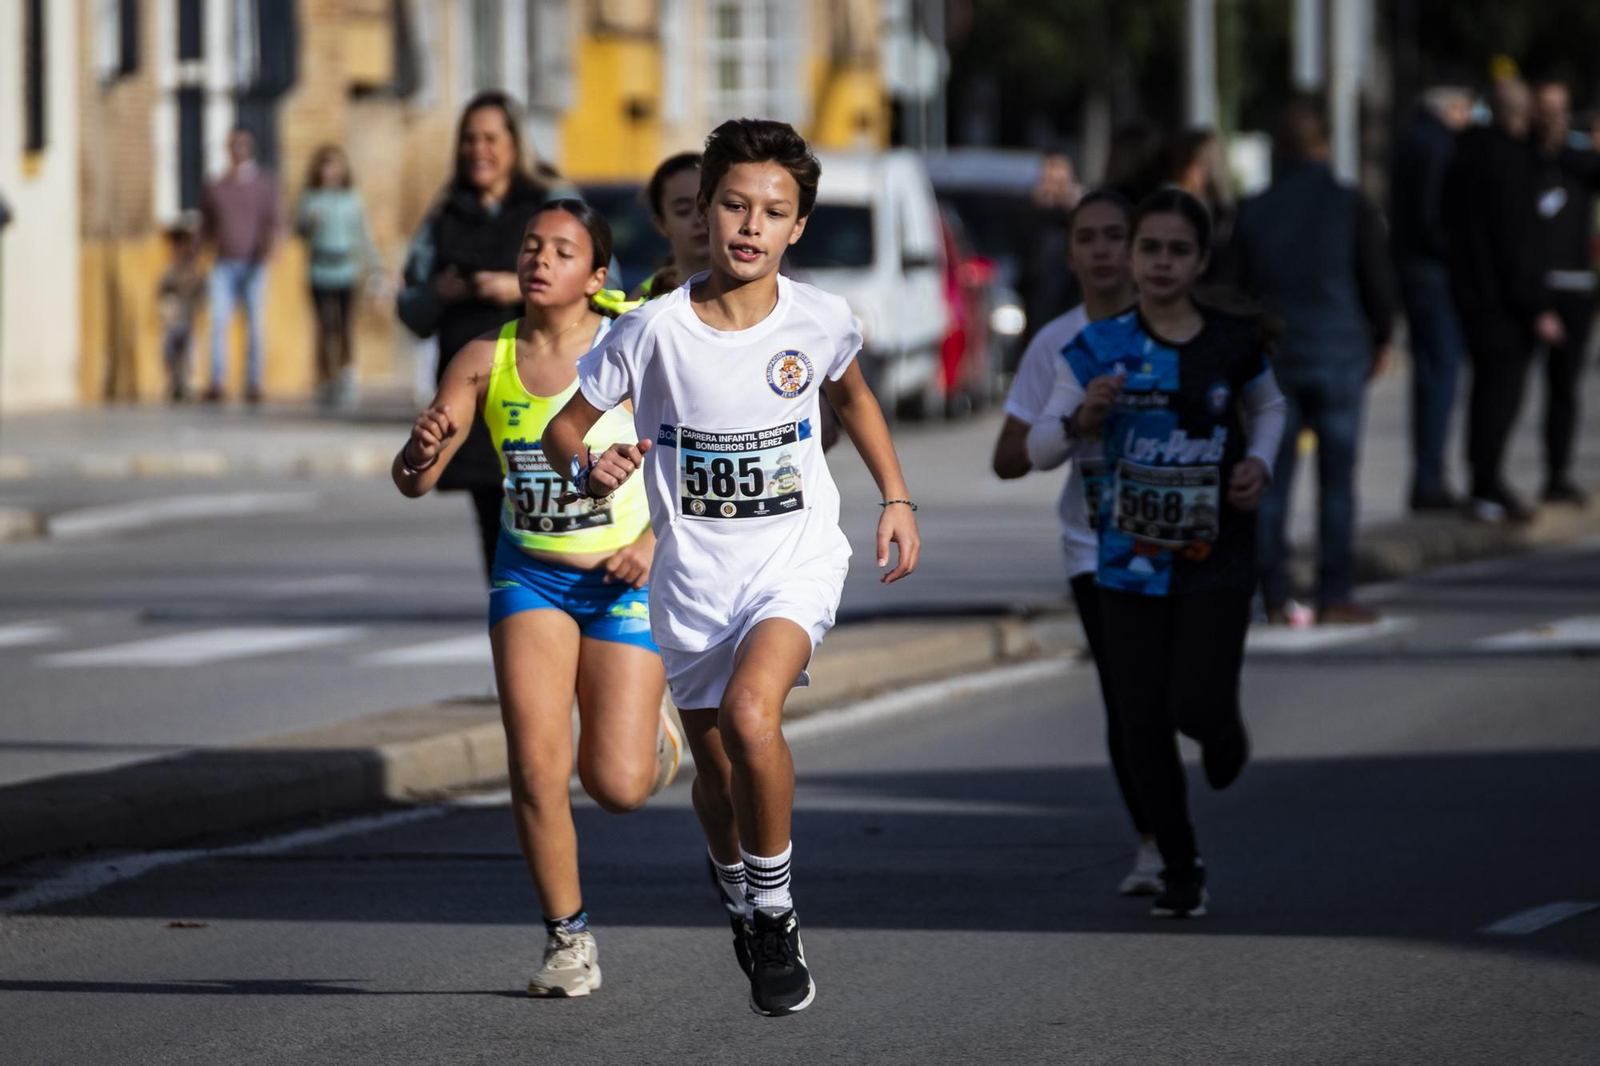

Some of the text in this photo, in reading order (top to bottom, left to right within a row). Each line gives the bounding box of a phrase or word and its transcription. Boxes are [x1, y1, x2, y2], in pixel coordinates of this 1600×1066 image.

[682, 424, 795, 443] CARRERA INFANTIL BENÉFICA
[695, 437, 783, 452] BOMBEROS DE JEREZ
[685, 454, 765, 498] 585
[515, 477, 569, 515] 577
[1121, 485, 1183, 523] 568
